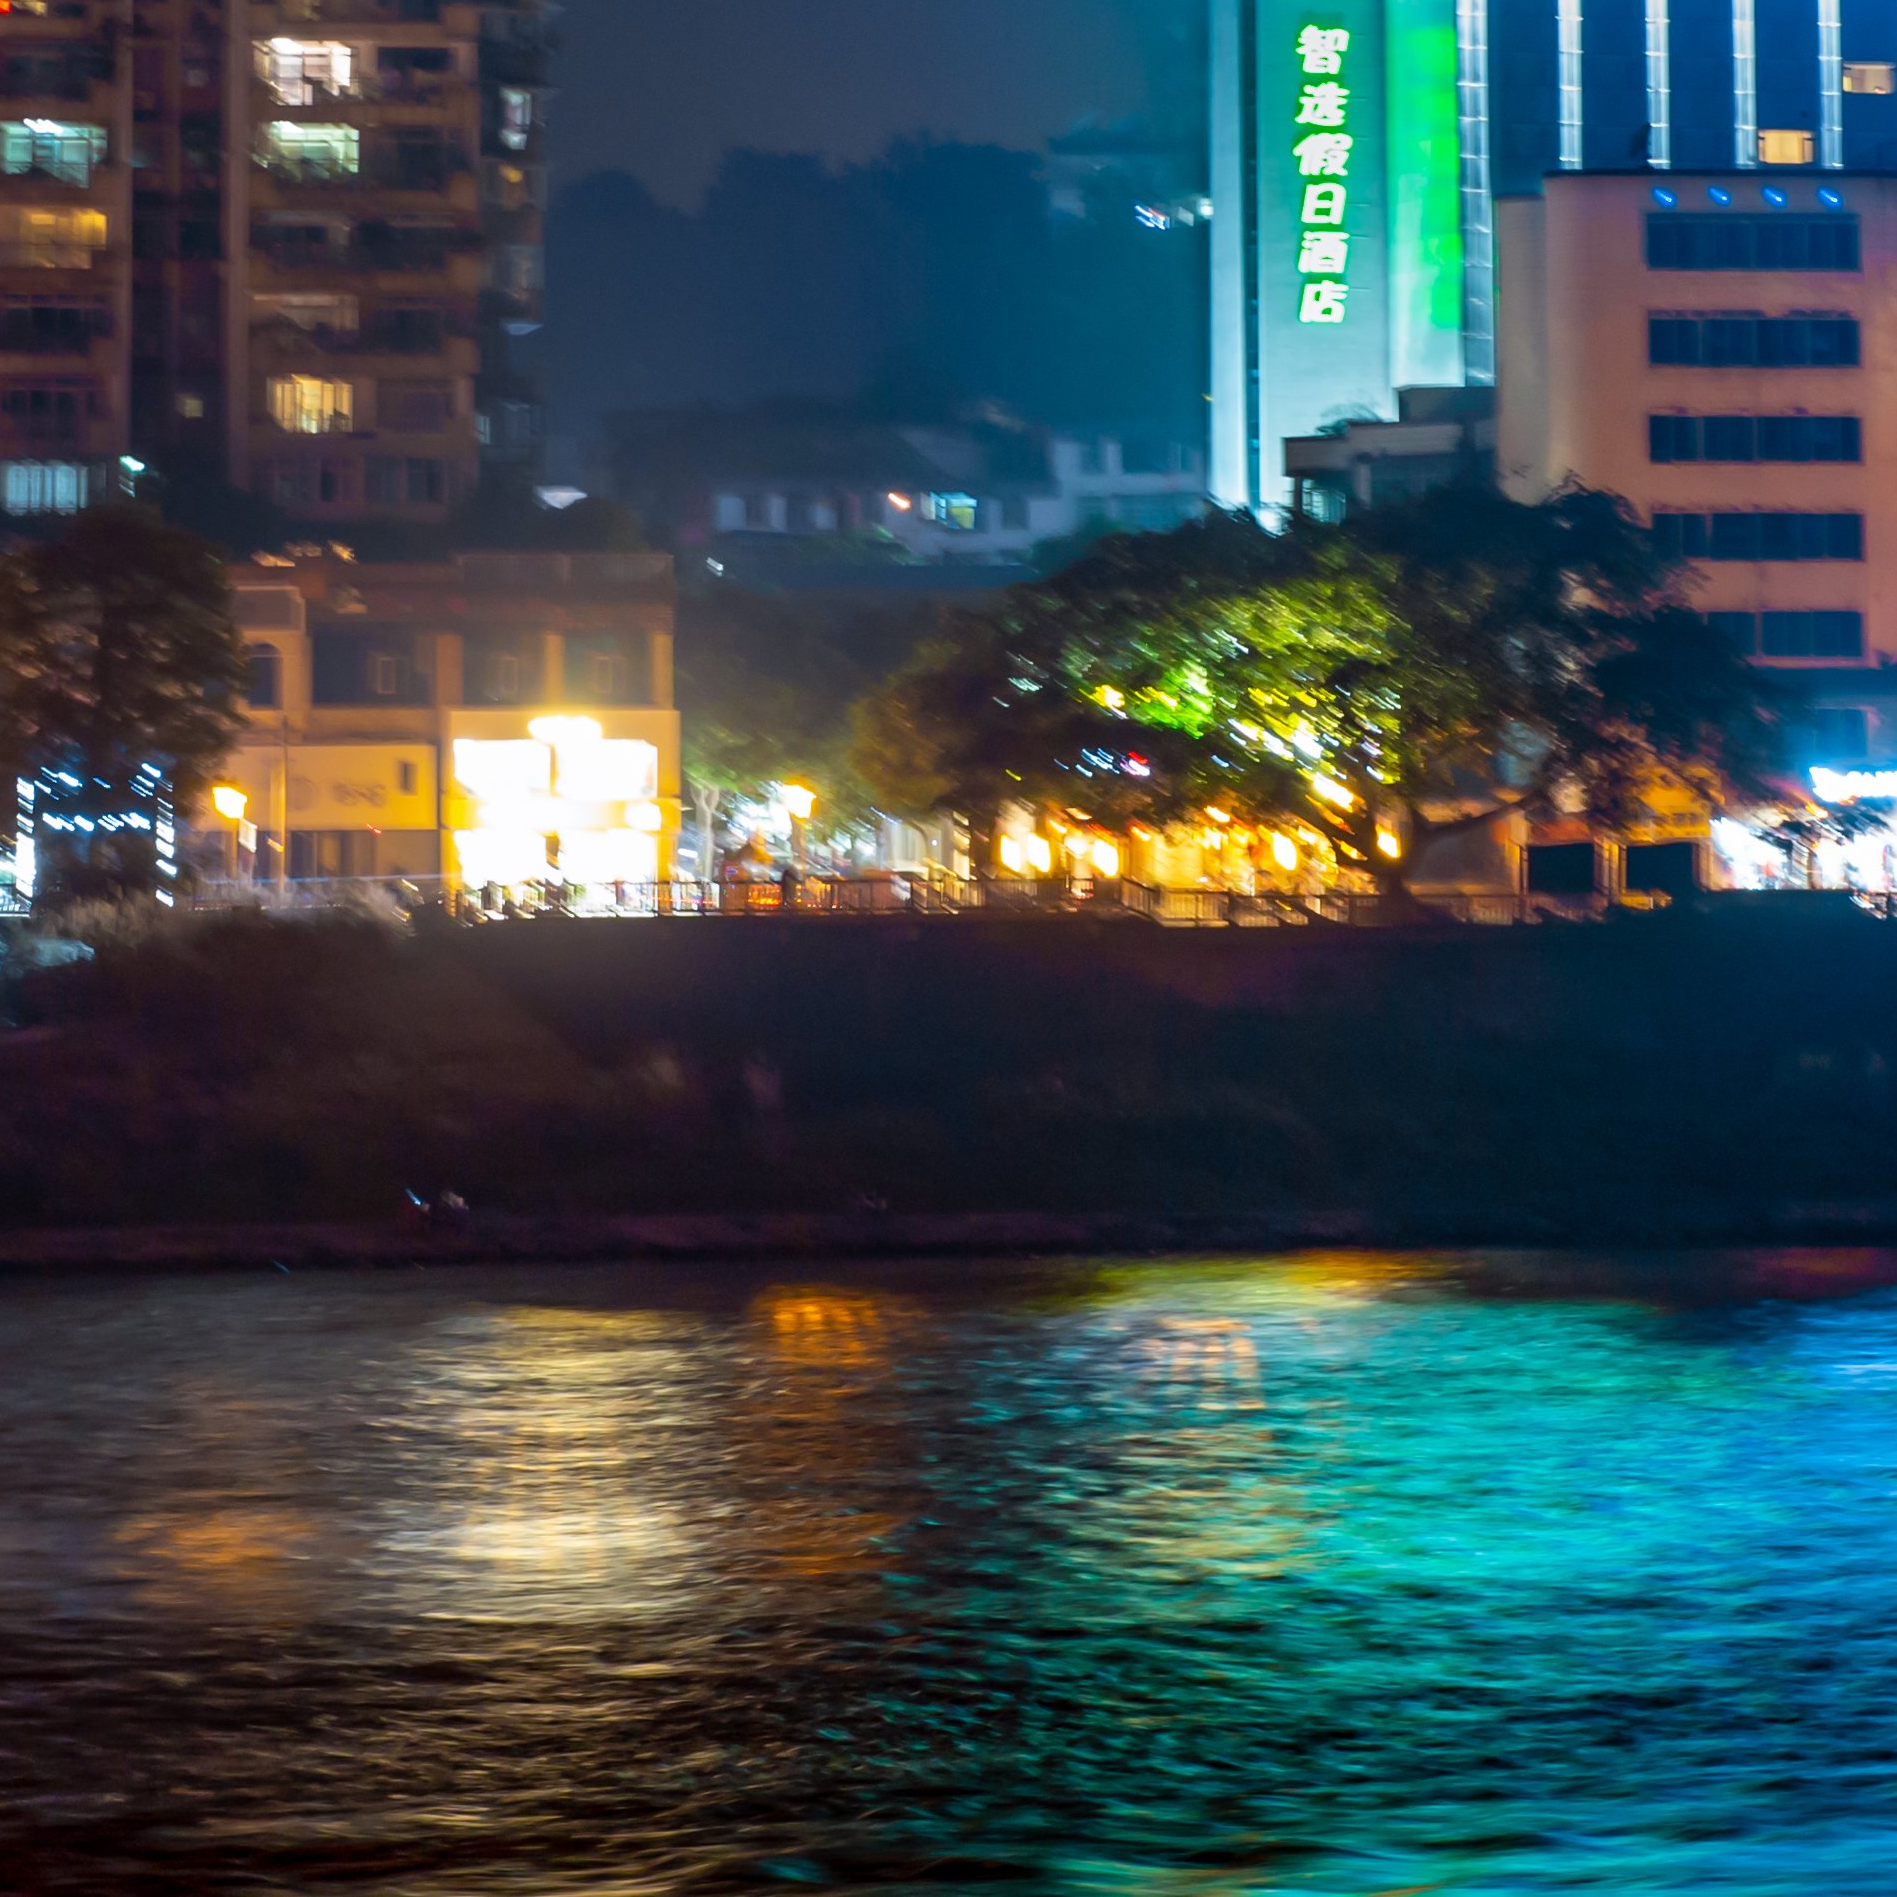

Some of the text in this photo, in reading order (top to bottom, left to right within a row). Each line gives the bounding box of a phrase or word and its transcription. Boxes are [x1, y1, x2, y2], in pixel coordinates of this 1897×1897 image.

[1292, 24, 1353, 324] 智选假日酒店
